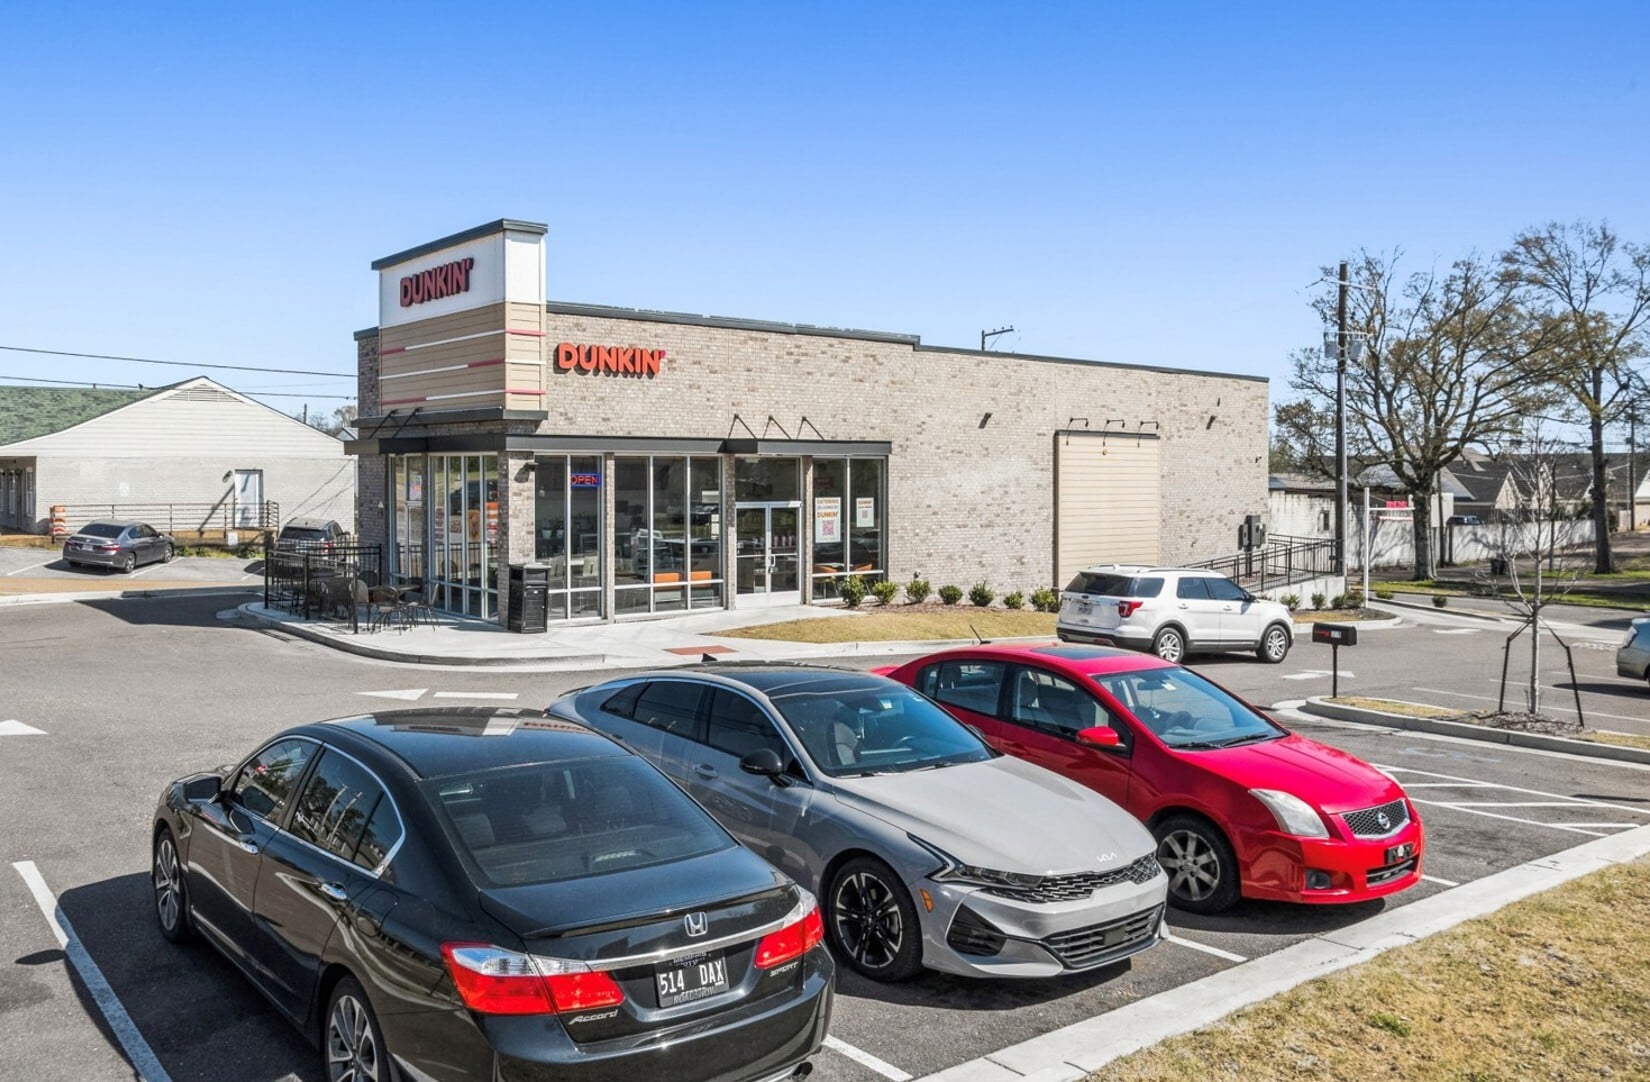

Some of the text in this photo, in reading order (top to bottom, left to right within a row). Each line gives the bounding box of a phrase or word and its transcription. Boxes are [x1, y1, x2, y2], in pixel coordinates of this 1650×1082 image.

[400, 257, 474, 307] DUNKIN'
[557, 343, 666, 376] DUNKIN'
[571, 475, 598, 486] OPEN
[660, 960, 724, 995] 514 DAX
[568, 1009, 618, 1025] Accord
